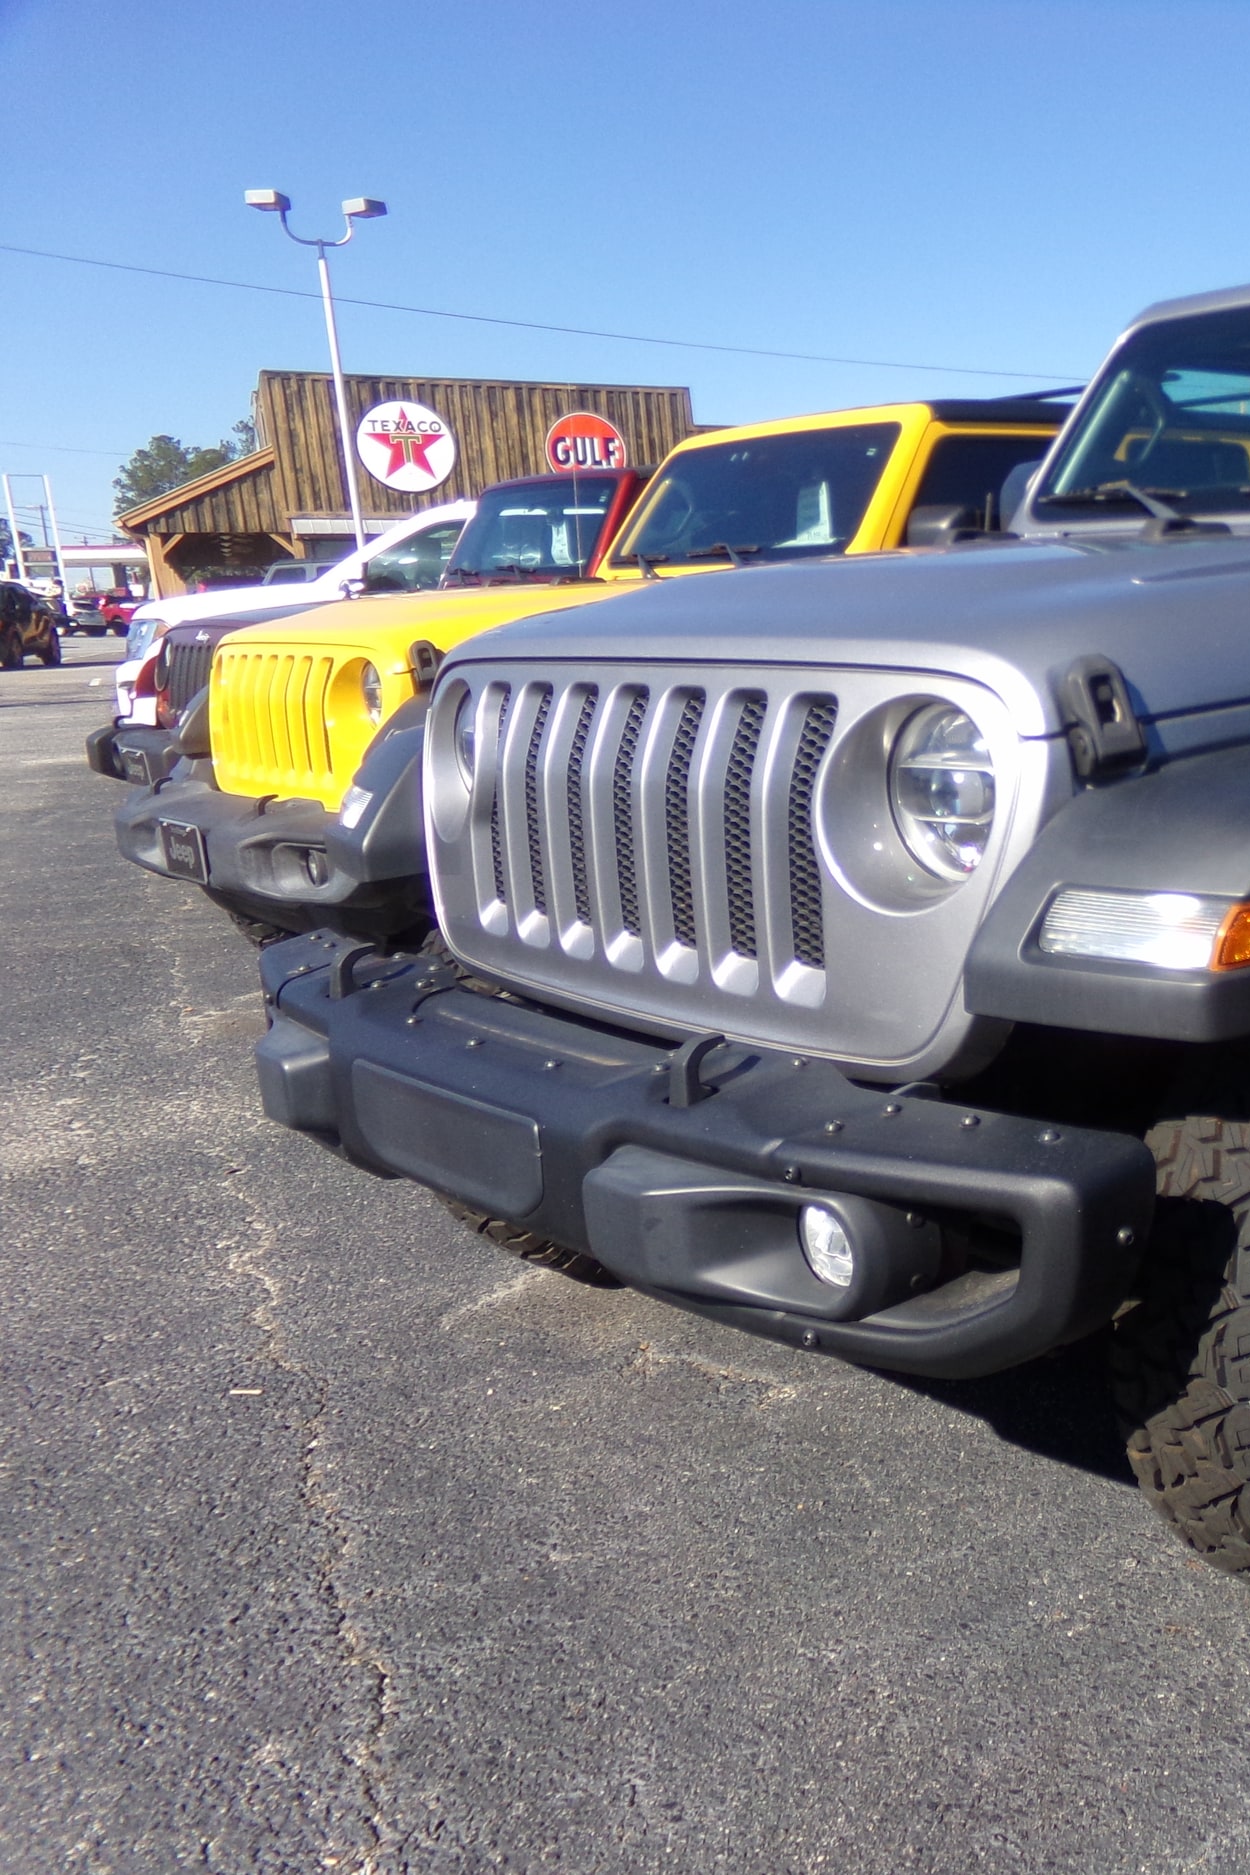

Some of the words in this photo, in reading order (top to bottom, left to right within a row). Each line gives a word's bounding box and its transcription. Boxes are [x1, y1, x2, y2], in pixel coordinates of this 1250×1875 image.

[367, 419, 442, 433] TEXACO
[551, 436, 620, 469] GULF
[169, 836, 195, 869] Jeep
